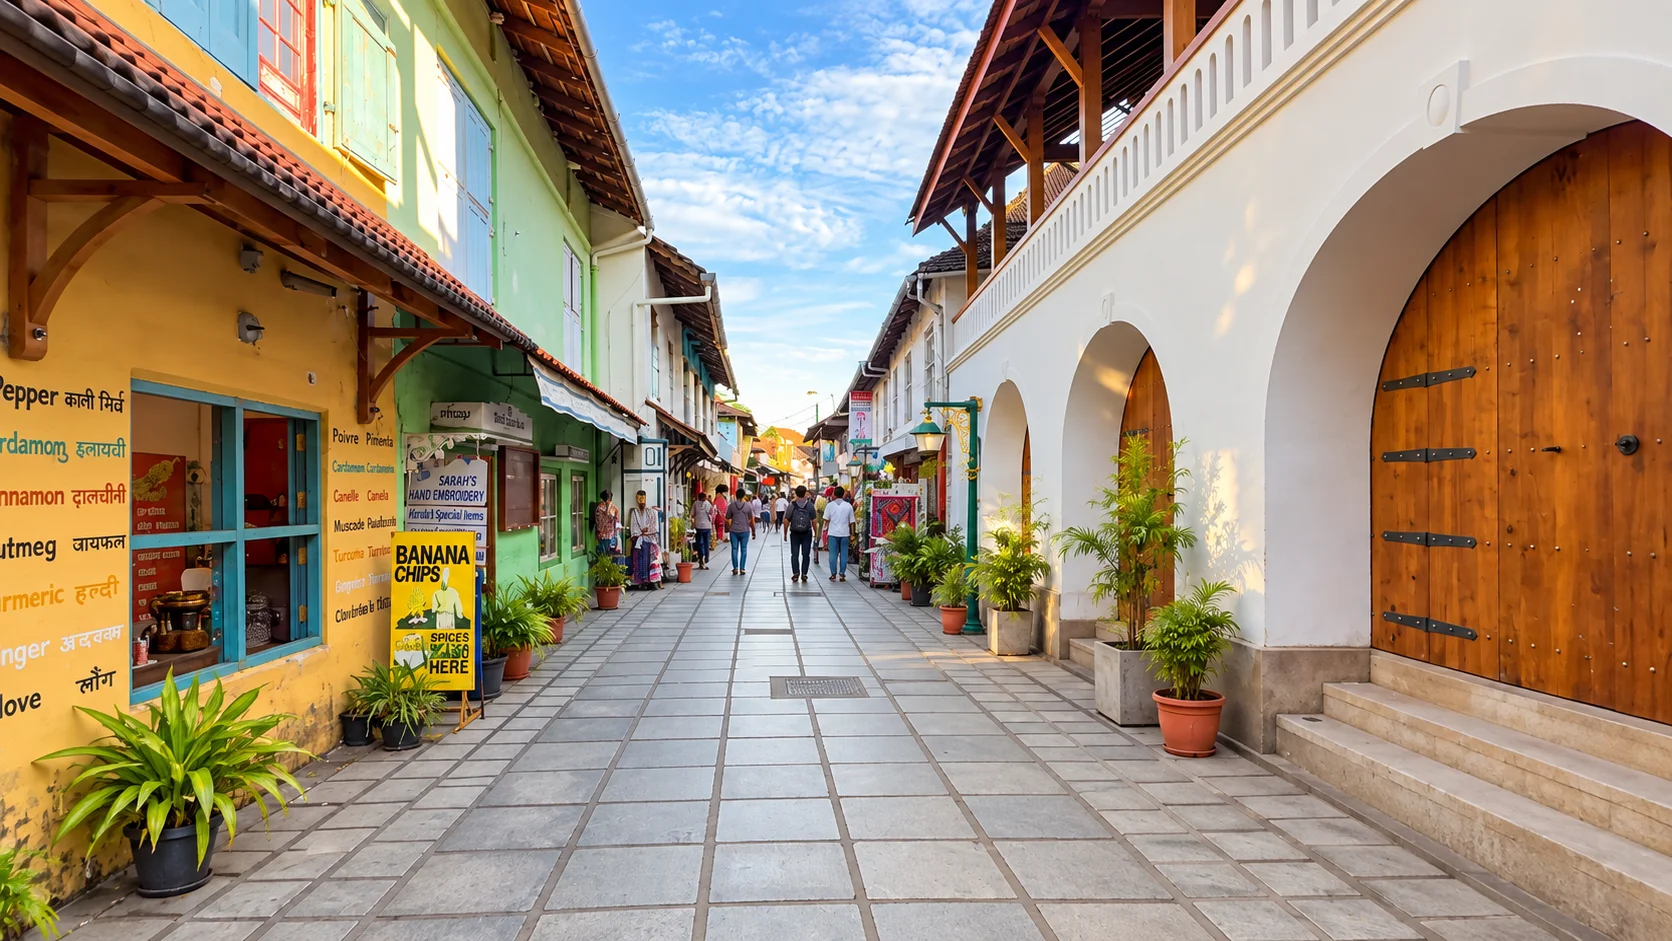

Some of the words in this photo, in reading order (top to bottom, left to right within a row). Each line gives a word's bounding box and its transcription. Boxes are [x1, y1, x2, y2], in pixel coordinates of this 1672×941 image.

[332, 428, 359, 444] Poivre
[438, 475, 477, 487] SARAH'S
[333, 489, 359, 502] Canelle
[367, 489, 389, 502] Canela
[408, 489, 431, 500] HAND
[433, 489, 485, 502] EMBROIDERY
[333, 518, 365, 533] Muscade
[396, 545, 470, 565] BANANA
[394, 566, 441, 582] CHIPS
[0, 583, 65, 612] rmeric
[430, 632, 470, 642] SPICES
[429, 660, 469, 675] HERE
